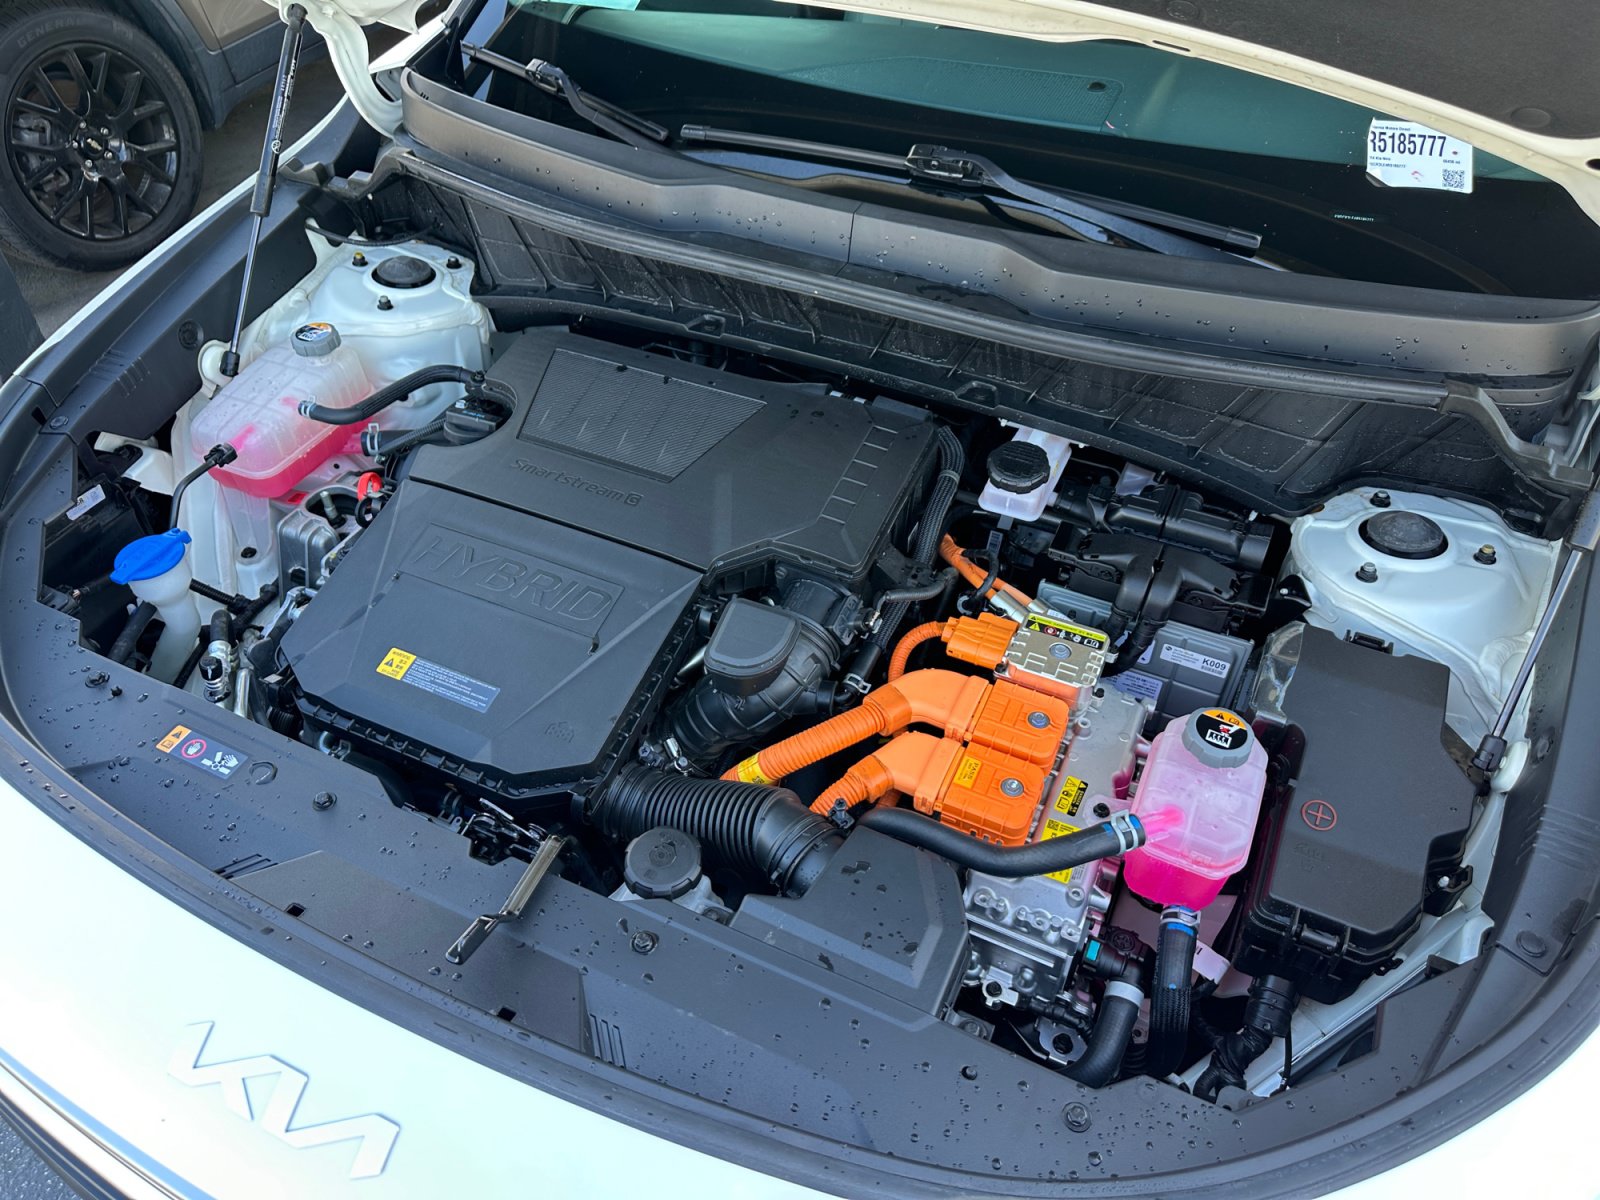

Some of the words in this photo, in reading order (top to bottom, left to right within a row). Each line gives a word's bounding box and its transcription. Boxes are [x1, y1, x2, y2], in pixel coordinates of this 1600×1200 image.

[511, 458, 625, 501] Smartstream
[411, 535, 613, 621] HYBRID
[1202, 657, 1227, 671] K009
